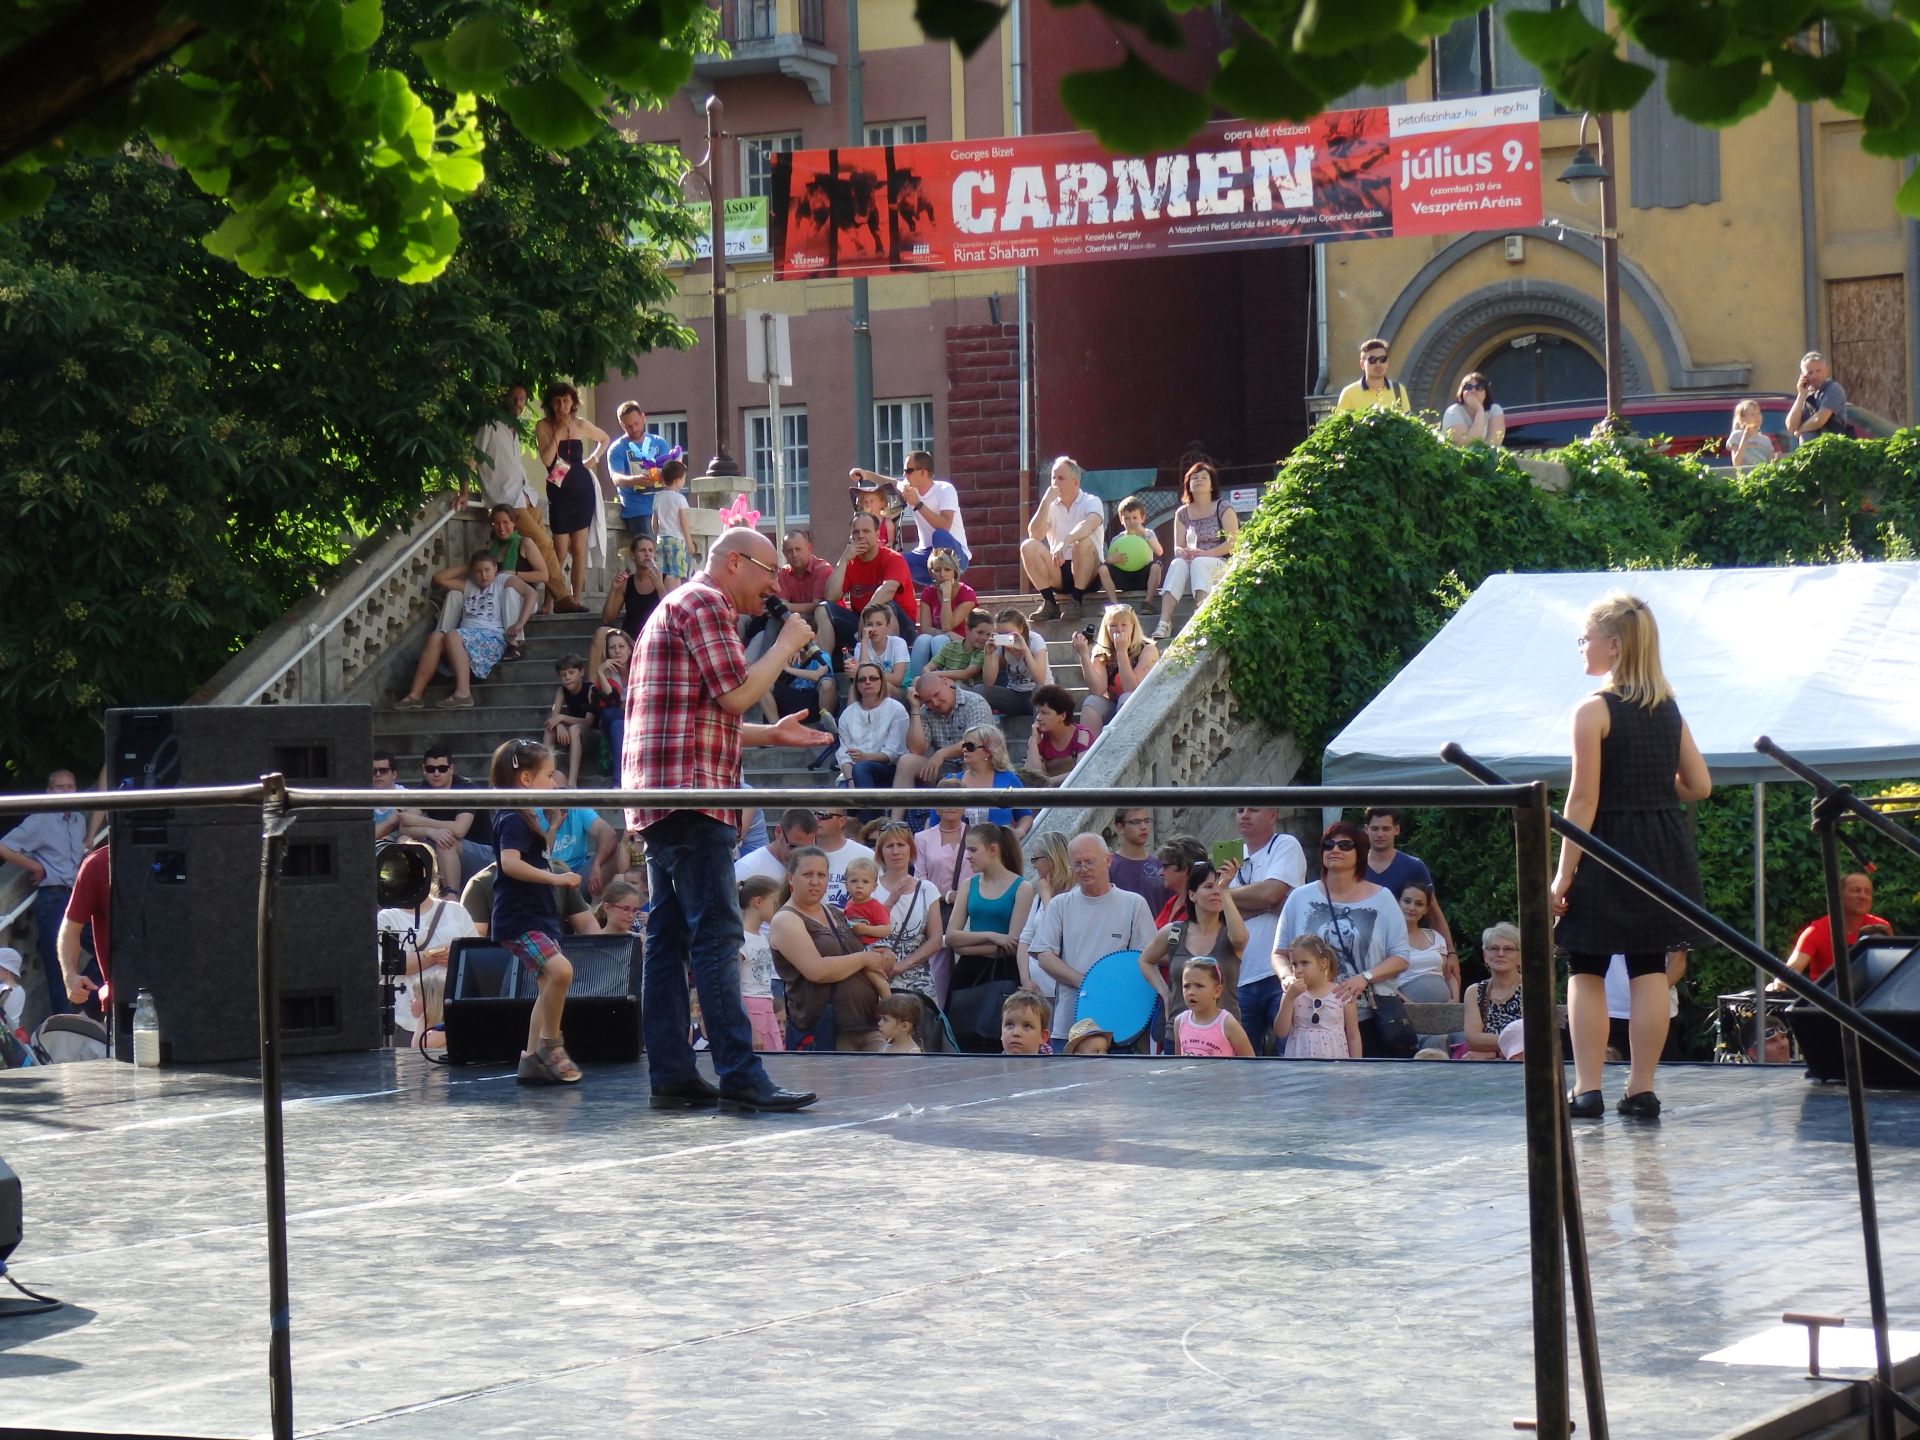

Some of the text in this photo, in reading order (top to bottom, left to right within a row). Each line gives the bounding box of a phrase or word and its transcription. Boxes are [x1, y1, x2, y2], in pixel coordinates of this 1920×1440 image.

[1398, 108, 1478, 128] petofiszinhaz.hu
[1493, 102, 1529, 118] jegy.hu
[1223, 125, 1311, 143] opera két részben
[950, 147, 1015, 162] Georges Bizet
[1400, 139, 1534, 191] július 9.
[952, 145, 1315, 235] CARMEN
[1430, 182, 1502, 197] (szombat) 20 óra
[1411, 195, 1523, 216] Veszprém Aréna
[1168, 227, 1175, 235] A
[1175, 223, 1210, 234] Veszprémi
[1210, 221, 1230, 231] Petőfi
[1230, 219, 1255, 230] Színház
[1256, 219, 1265, 227] és
[1271, 217, 1295, 227] Magyar
[1297, 214, 1318, 224] Állami
[1318, 211, 1352, 223] Operaház
[1116, 229, 1142, 240] Gergely
[953, 247, 986, 262] Rinat
[989, 244, 1039, 260] Shaham
[1085, 243, 1118, 253] Oberfrank
